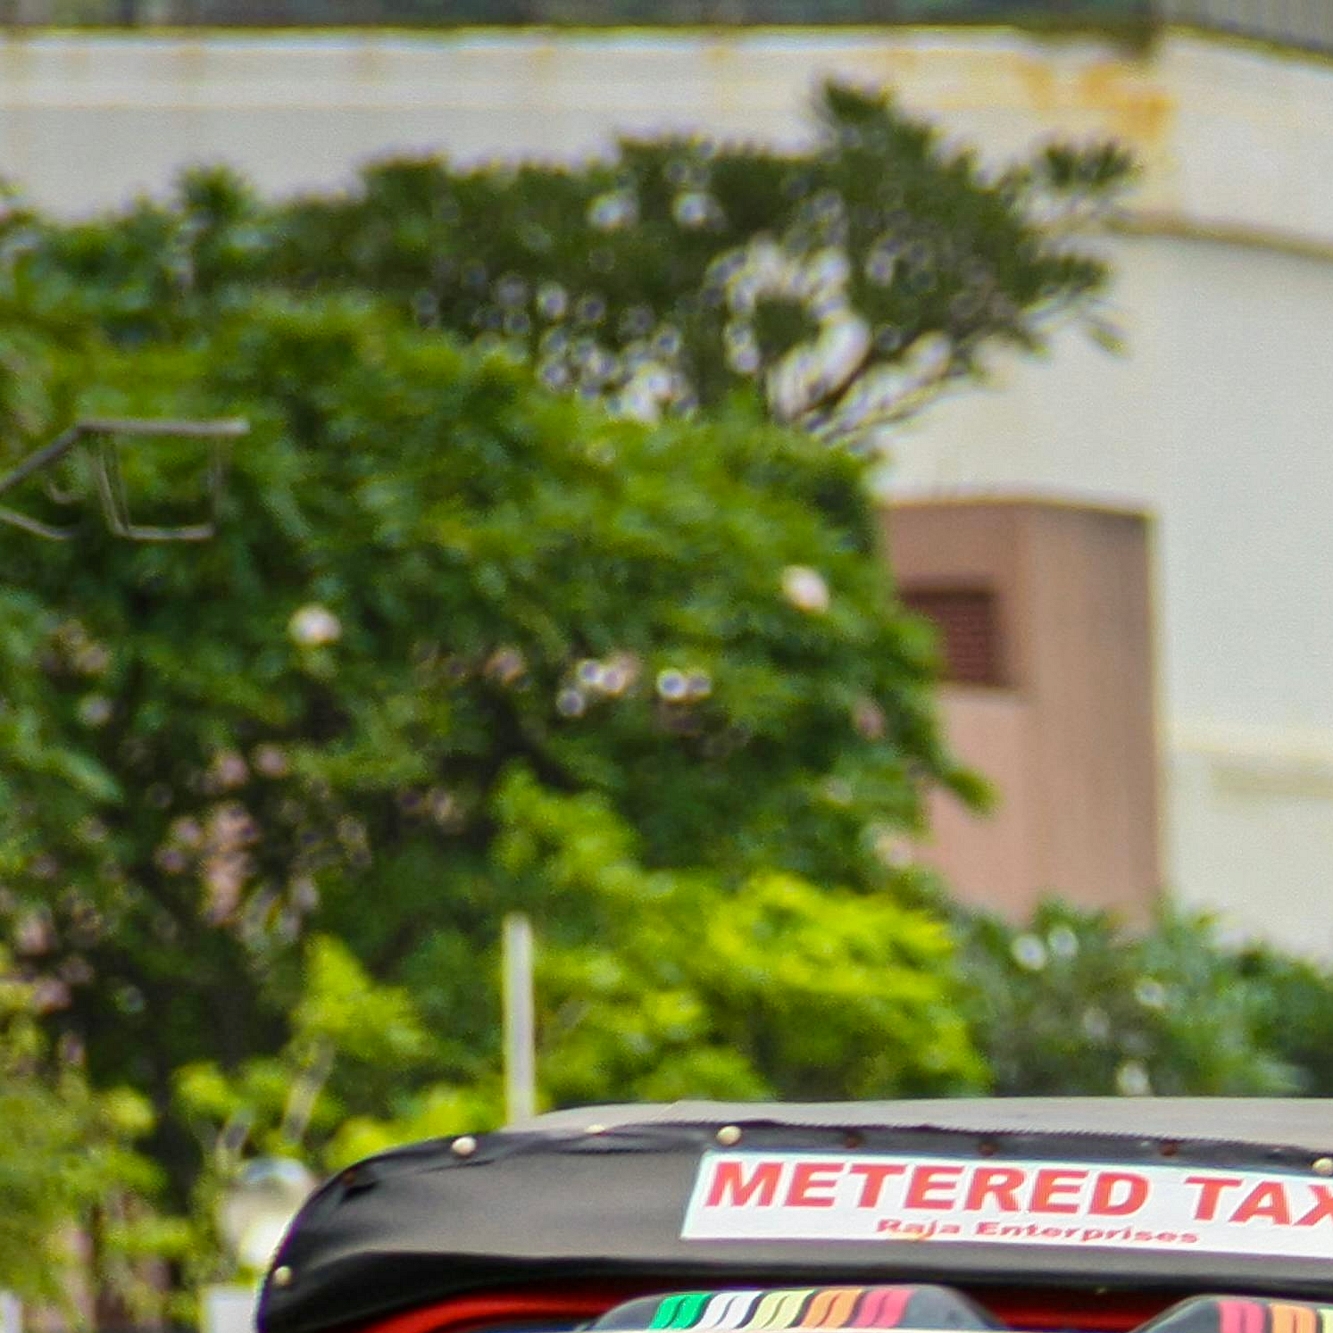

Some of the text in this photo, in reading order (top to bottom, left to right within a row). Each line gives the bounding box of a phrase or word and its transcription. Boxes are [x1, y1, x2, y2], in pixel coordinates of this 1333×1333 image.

[704, 1161, 1151, 1216] METERED
[876, 1218, 1198, 1244] Raja Enterprises
